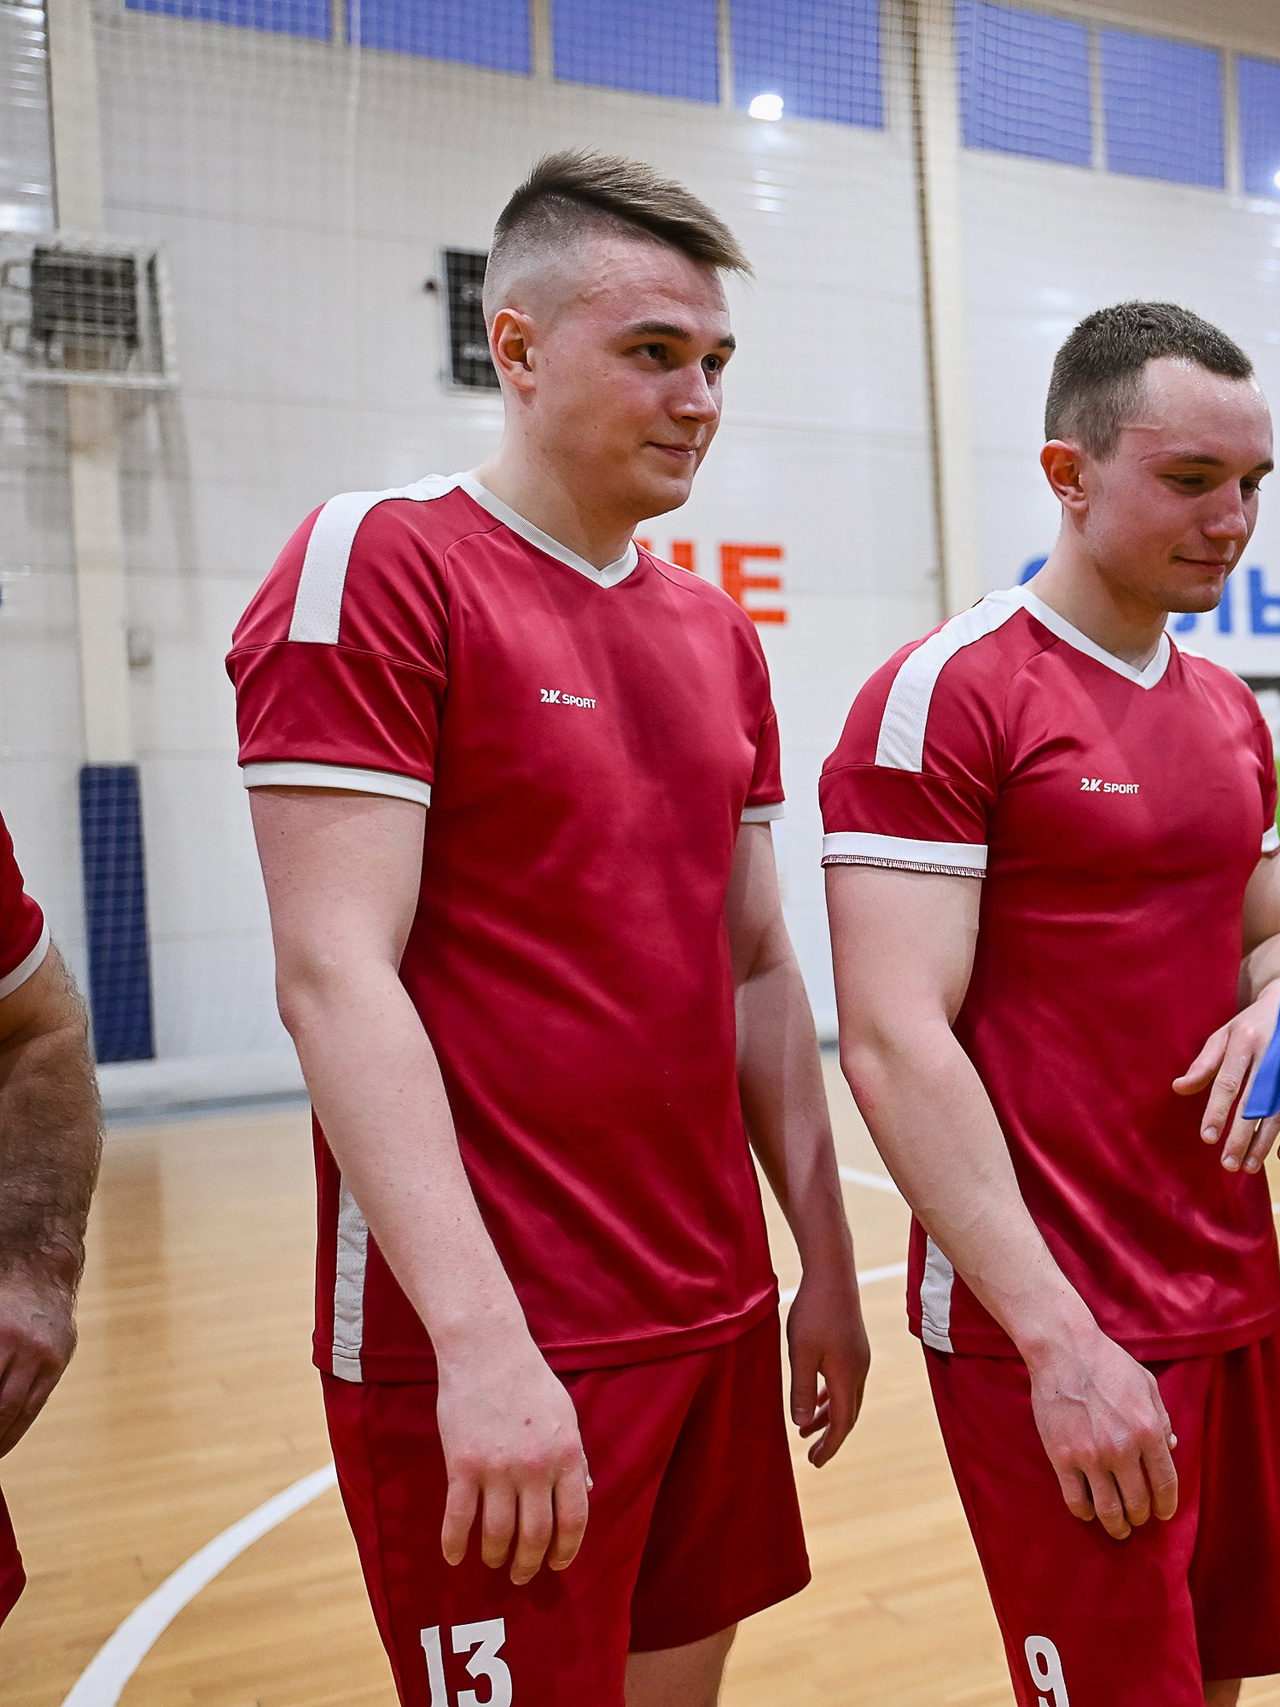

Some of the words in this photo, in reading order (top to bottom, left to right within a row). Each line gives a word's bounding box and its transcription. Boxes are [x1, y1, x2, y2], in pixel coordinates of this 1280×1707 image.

[540, 688, 561, 704] 2K
[562, 693, 597, 709] SPORT
[1079, 777, 1103, 792] 2K
[1103, 782, 1140, 794] SPORT
[420, 1617, 513, 1707] 13
[1024, 1635, 1070, 1707] 9
